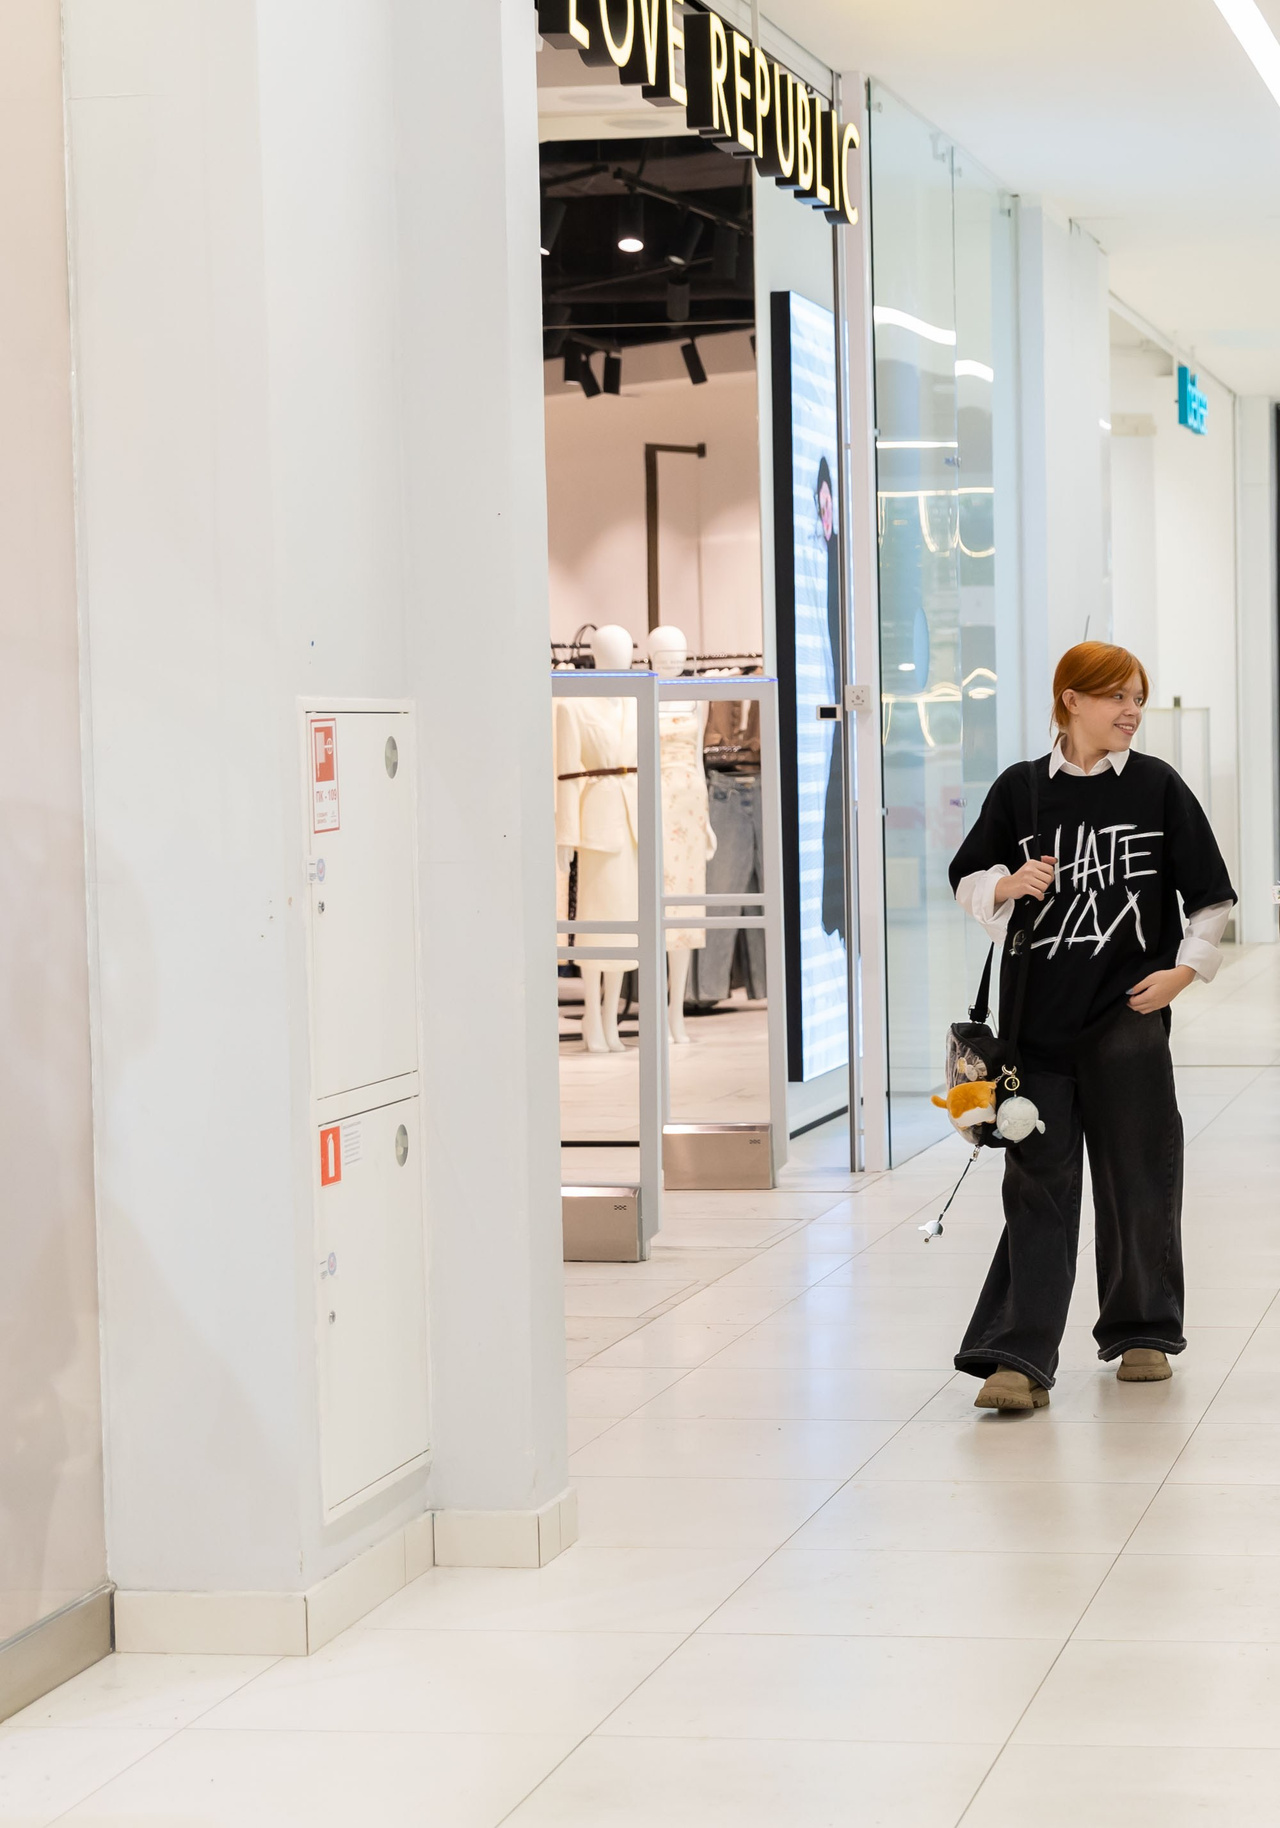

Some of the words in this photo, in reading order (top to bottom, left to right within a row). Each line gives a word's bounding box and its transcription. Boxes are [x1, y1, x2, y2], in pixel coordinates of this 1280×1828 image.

[569, 0, 687, 107] OVE
[709, 12, 860, 225] REPUBLIC
[1054, 821, 1164, 893] HATE
